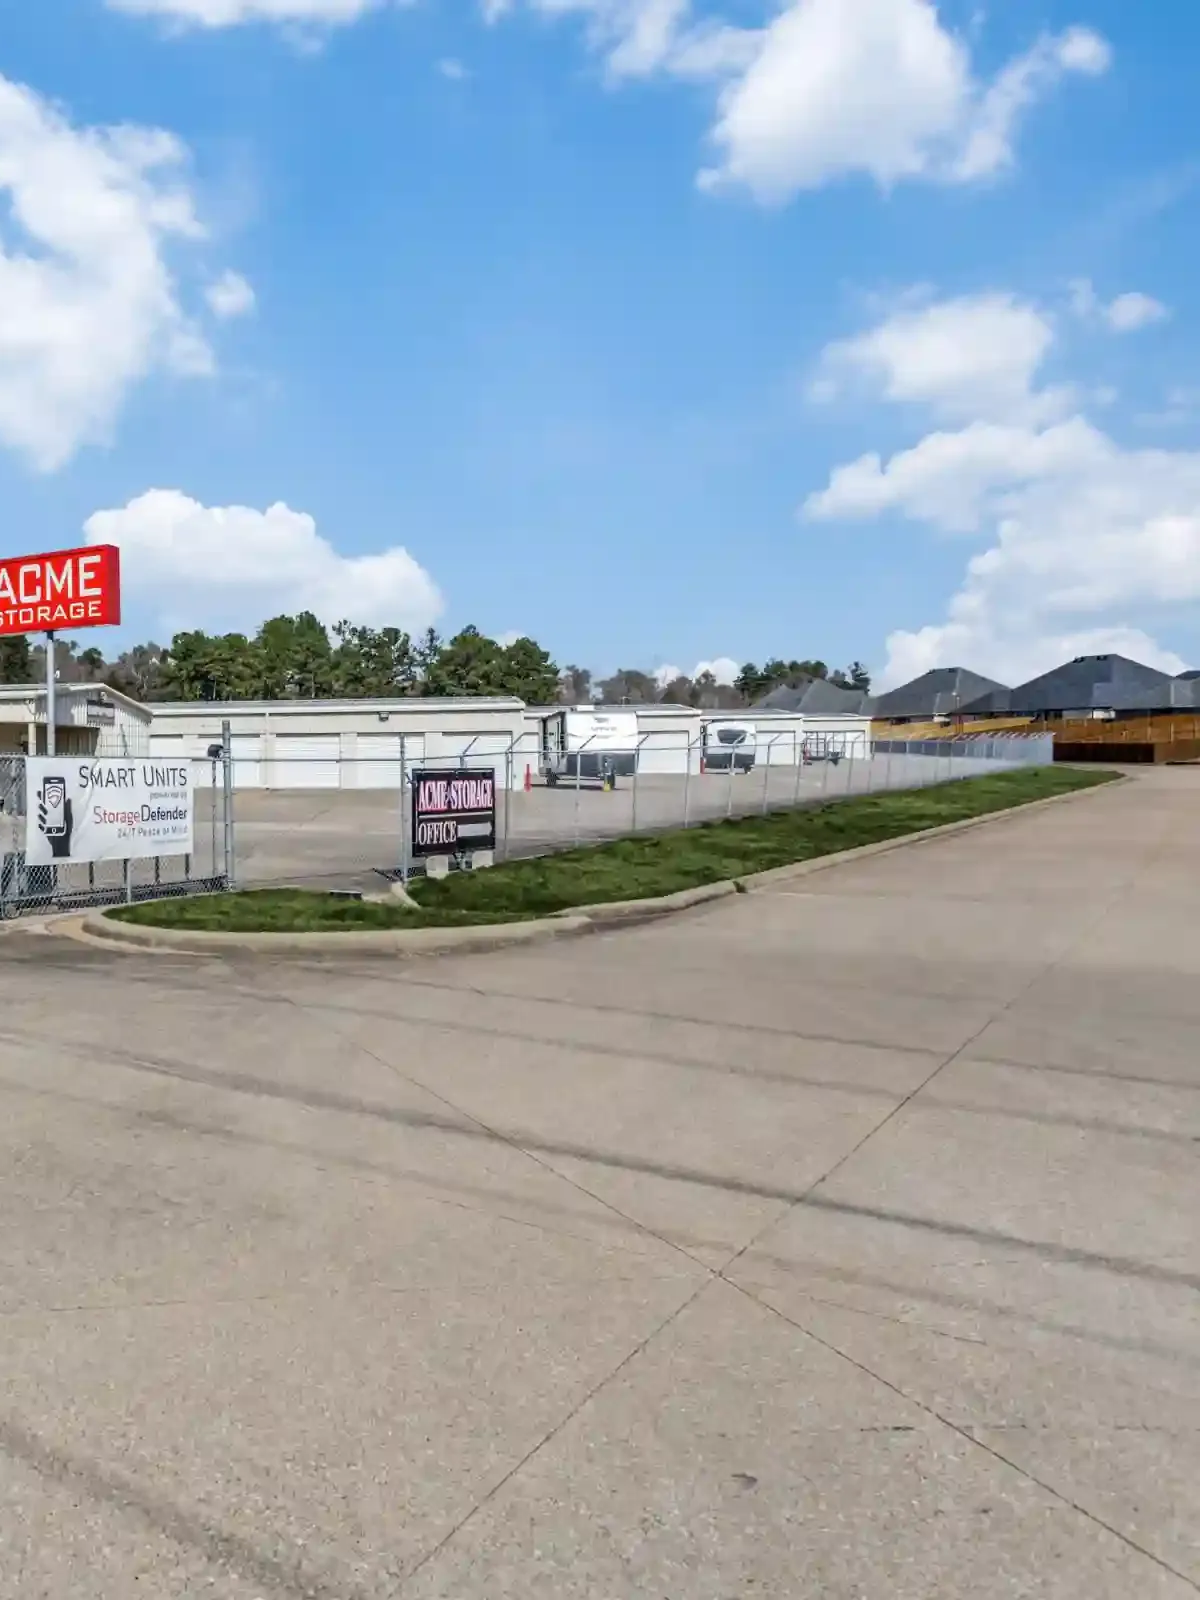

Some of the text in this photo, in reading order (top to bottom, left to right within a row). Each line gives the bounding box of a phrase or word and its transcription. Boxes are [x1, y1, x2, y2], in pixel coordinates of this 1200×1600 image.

[79, 765, 188, 788] SMART UNITS
[418, 779, 493, 812] ACME STORAGE
[93, 804, 188, 826] StorageDefender
[418, 821, 457, 846] OFFICE
